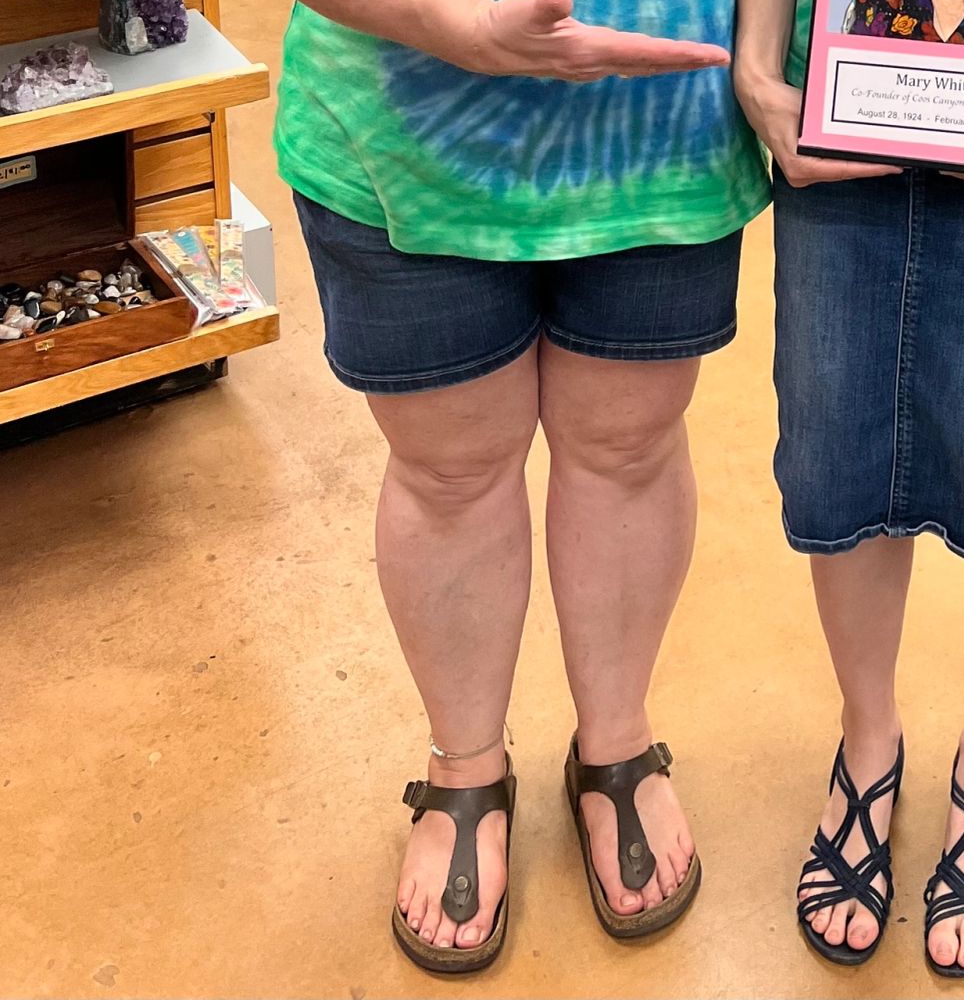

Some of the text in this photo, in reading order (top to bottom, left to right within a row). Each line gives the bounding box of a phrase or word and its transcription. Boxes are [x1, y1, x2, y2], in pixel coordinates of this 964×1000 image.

[896, 73, 931, 91] Mary
[851, 87, 900, 101] Co-Founder
[902, 91, 911, 104] of
[912, 94, 930, 103] Coos
[932, 95, 964, 109] Canyon
[857, 107, 886, 119] August
[887, 110, 900, 121] 28,
[903, 112, 922, 121] 1924
